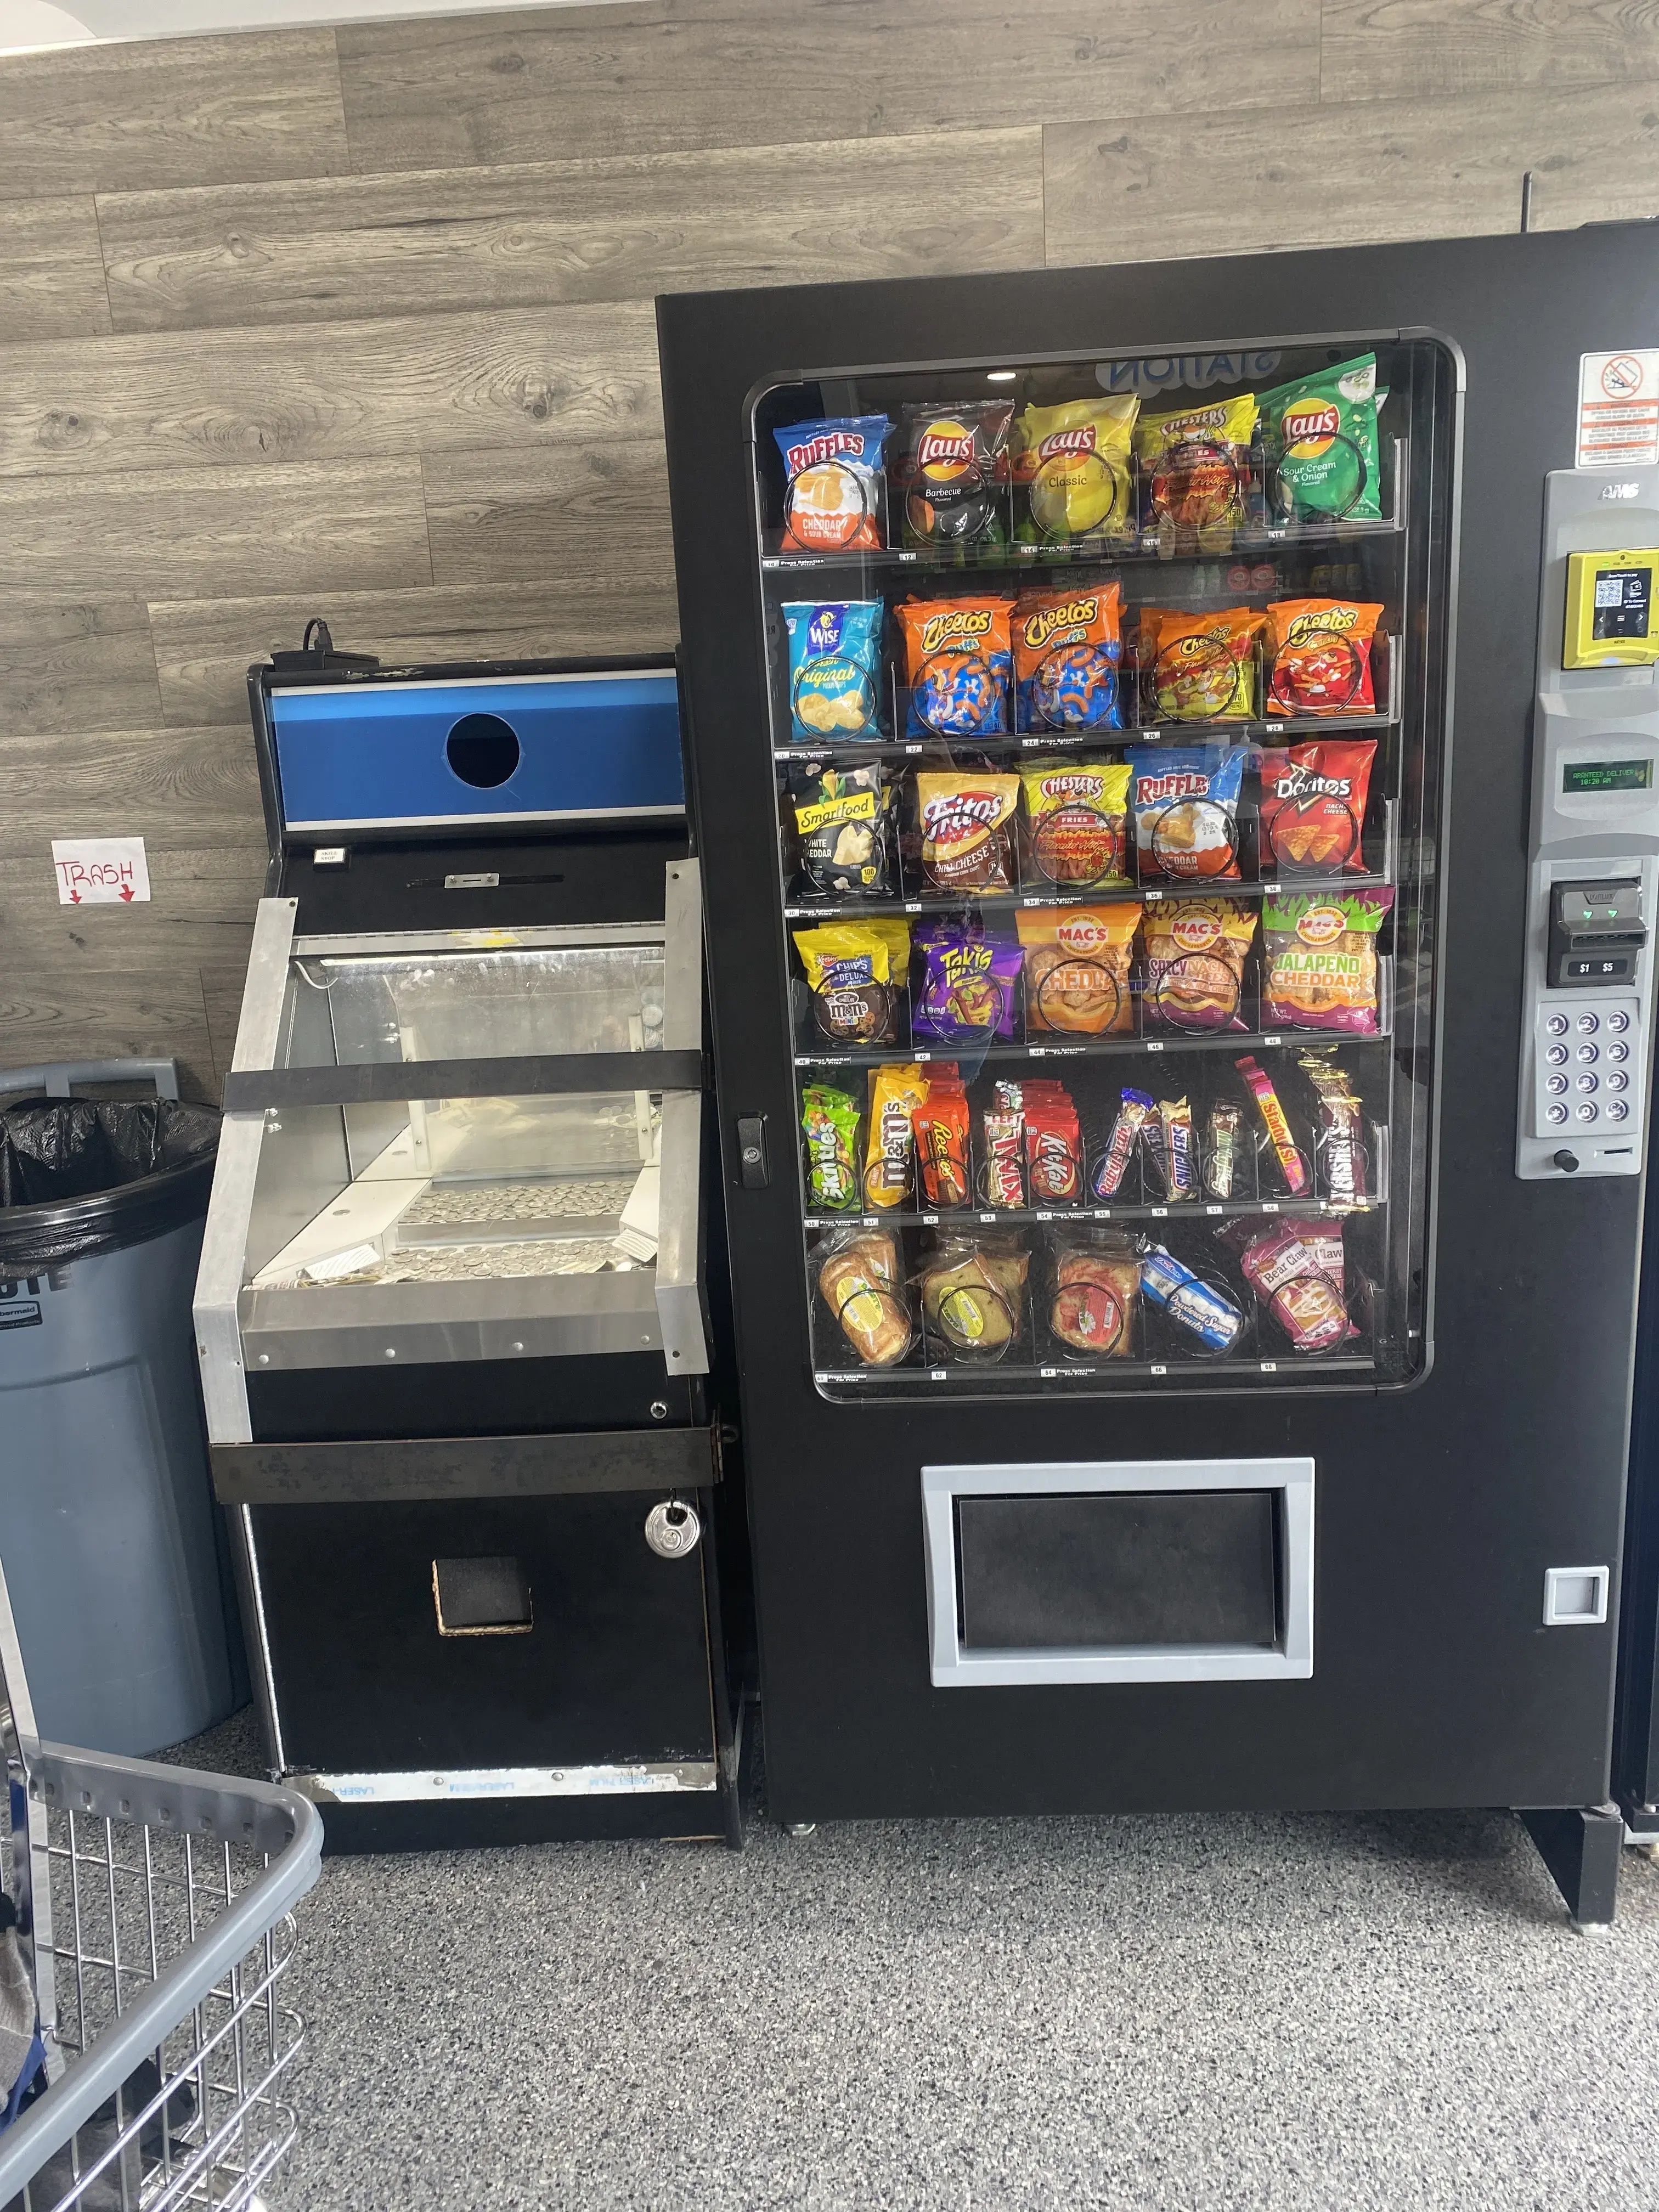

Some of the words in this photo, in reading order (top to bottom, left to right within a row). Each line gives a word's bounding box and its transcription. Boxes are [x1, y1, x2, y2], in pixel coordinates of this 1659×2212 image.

[1285, 409, 1335, 445] Lay's
[921, 436, 972, 467] Lay's
[1041, 427, 1094, 459] Lay's
[788, 434, 864, 475] RUFFLES
[1283, 466, 1304, 476] Sour
[1306, 461, 1336, 472] Cream
[1293, 475, 1300, 483] &
[1301, 472, 1328, 482] Onion
[1048, 475, 1087, 488] Classic
[1598, 483, 1640, 500] AMS
[926, 488, 961, 498] Barbecue
[803, 518, 842, 531] CHEDDAR
[923, 612, 992, 651] Cheetos
[1026, 601, 1096, 646] Cheetos
[1290, 608, 1355, 645] Cheetos
[811, 629, 839, 644] WISE
[793, 664, 855, 688] Original
[1042, 776, 1104, 799] CHESTER'S
[1277, 778, 1352, 798] Doritos
[801, 800, 870, 828] Smartfood
[923, 794, 1003, 842] Fritos
[956, 846, 990, 871] CHEESE
[55, 861, 133, 887] TRASH
[1058, 927, 1107, 941] MAC'S
[1172, 922, 1221, 934] MAC'S
[817, 955, 839, 963] Keebler
[836, 960, 868, 971] CHIPS
[940, 945, 993, 988] Takis
[1273, 952, 1361, 974] JALAPEÑO
[1579, 963, 1590, 973] $1
[1602, 963, 1613, 972] $5
[1271, 972, 1361, 988] CHEDDAR
[1554, 1020, 1559, 1030] 1
[1582, 1018, 1591, 1028] 2
[1615, 1017, 1621, 1026] 3
[1552, 1049, 1560, 1059] 4
[1583, 1048, 1591, 1058] 5
[1614, 1046, 1621, 1056] 6
[1552, 1079, 1560, 1088] 7
[1583, 1077, 1590, 1087] 8
[1613, 1076, 1620, 1086] 9
[1582, 1107, 1589, 1116] 0
[995, 1130, 1023, 1201] TWIX
[1173, 1126, 1192, 1190] SNICKERS
[1263, 1263, 1289, 1284] Bear
[1286, 1247, 1308, 1266] Claw
[1314, 1248, 1342, 1261] Claw
[1169, 1306, 1205, 1333] Donuts
[1170, 1293, 1206, 1323] Powdered
[1206, 1316, 1231, 1335] Sugar
